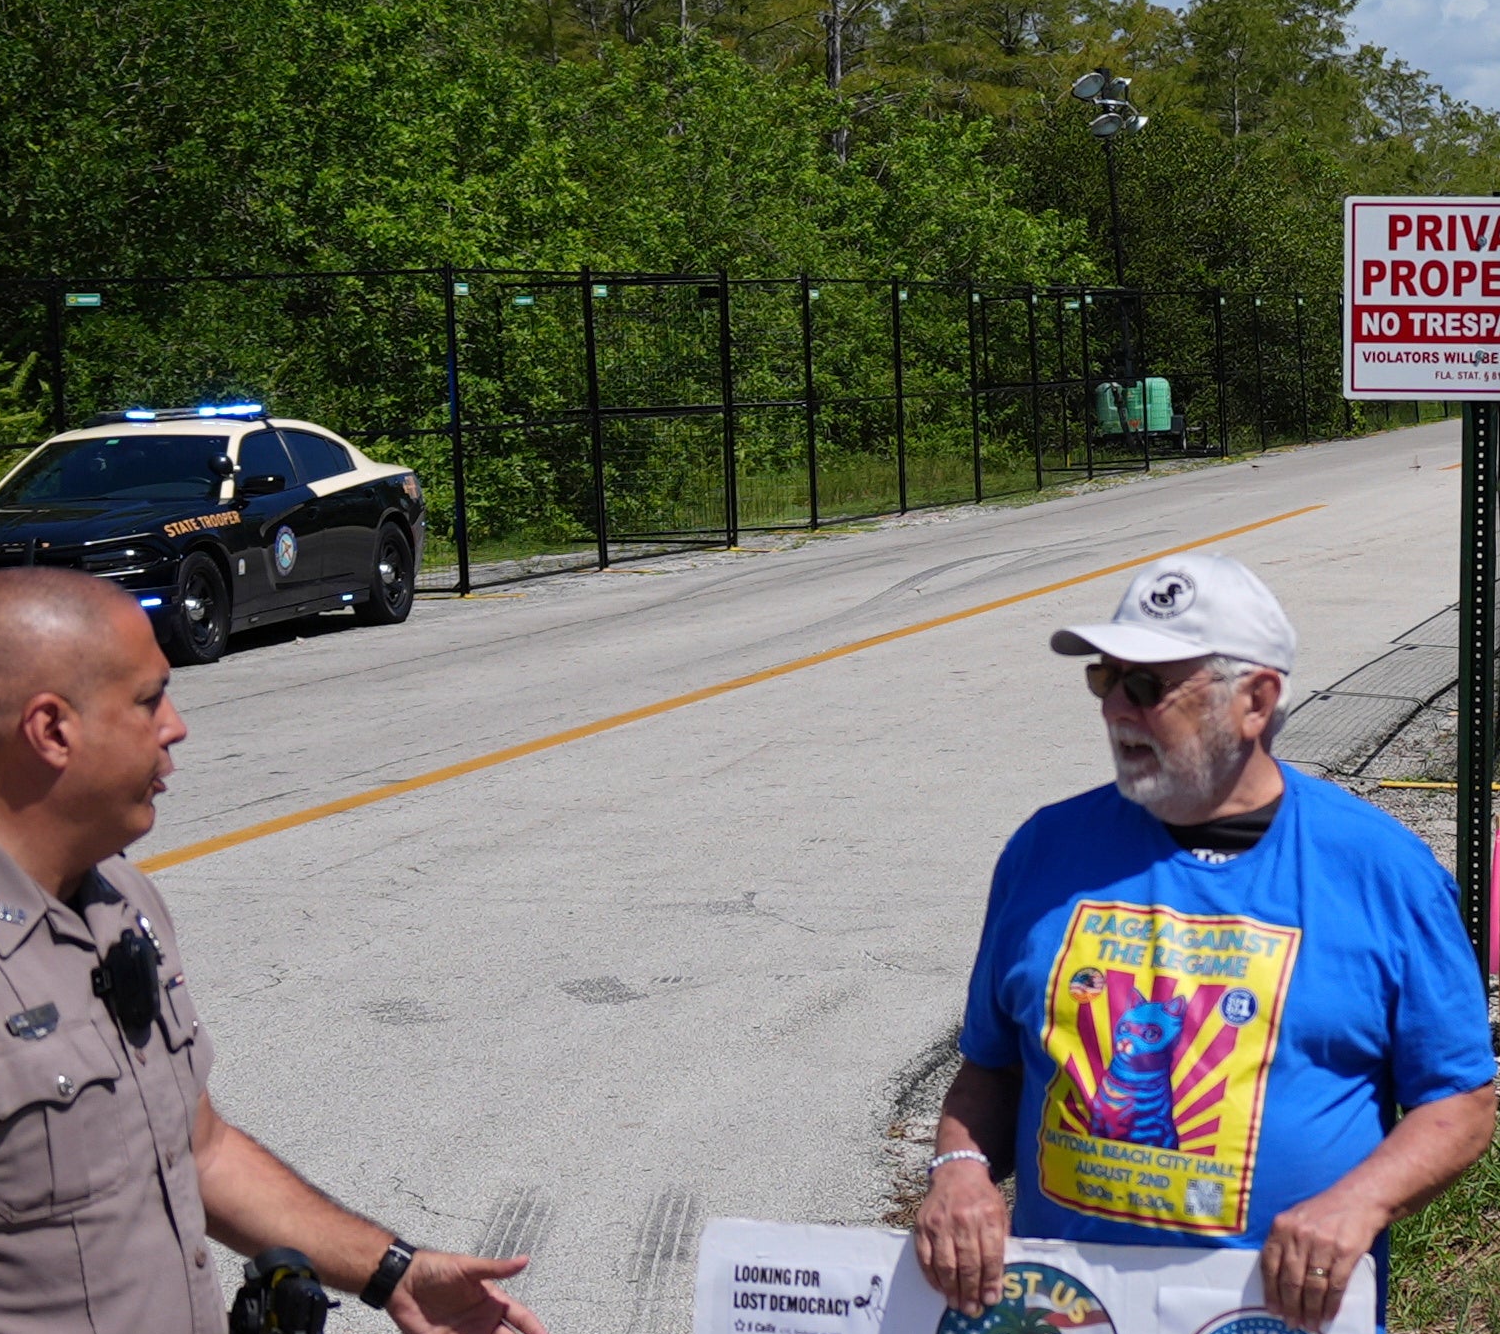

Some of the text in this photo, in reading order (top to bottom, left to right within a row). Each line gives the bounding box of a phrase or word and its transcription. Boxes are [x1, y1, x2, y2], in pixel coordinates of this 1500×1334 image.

[1360, 311, 1401, 337] NO
[1361, 350, 1440, 365] VIOLATORS
[1443, 351, 1477, 365] WILL
[1480, 351, 1499, 365] BE
[1434, 370, 1455, 381] FLA.
[1456, 370, 1481, 381] STAT.
[163, 510, 242, 539] STATE TROOPER
[1082, 913, 1281, 957] RAGE AGAINST
[1097, 938, 1250, 978] THE REGIME
[1155, 1154, 1193, 1172] CITY
[1196, 1160, 1236, 1179] HALL
[734, 1264, 820, 1288] LOOKING FOR
[733, 1291, 851, 1318] LOST DEMOCRACY
[1001, 1270, 1093, 1325] ST US
